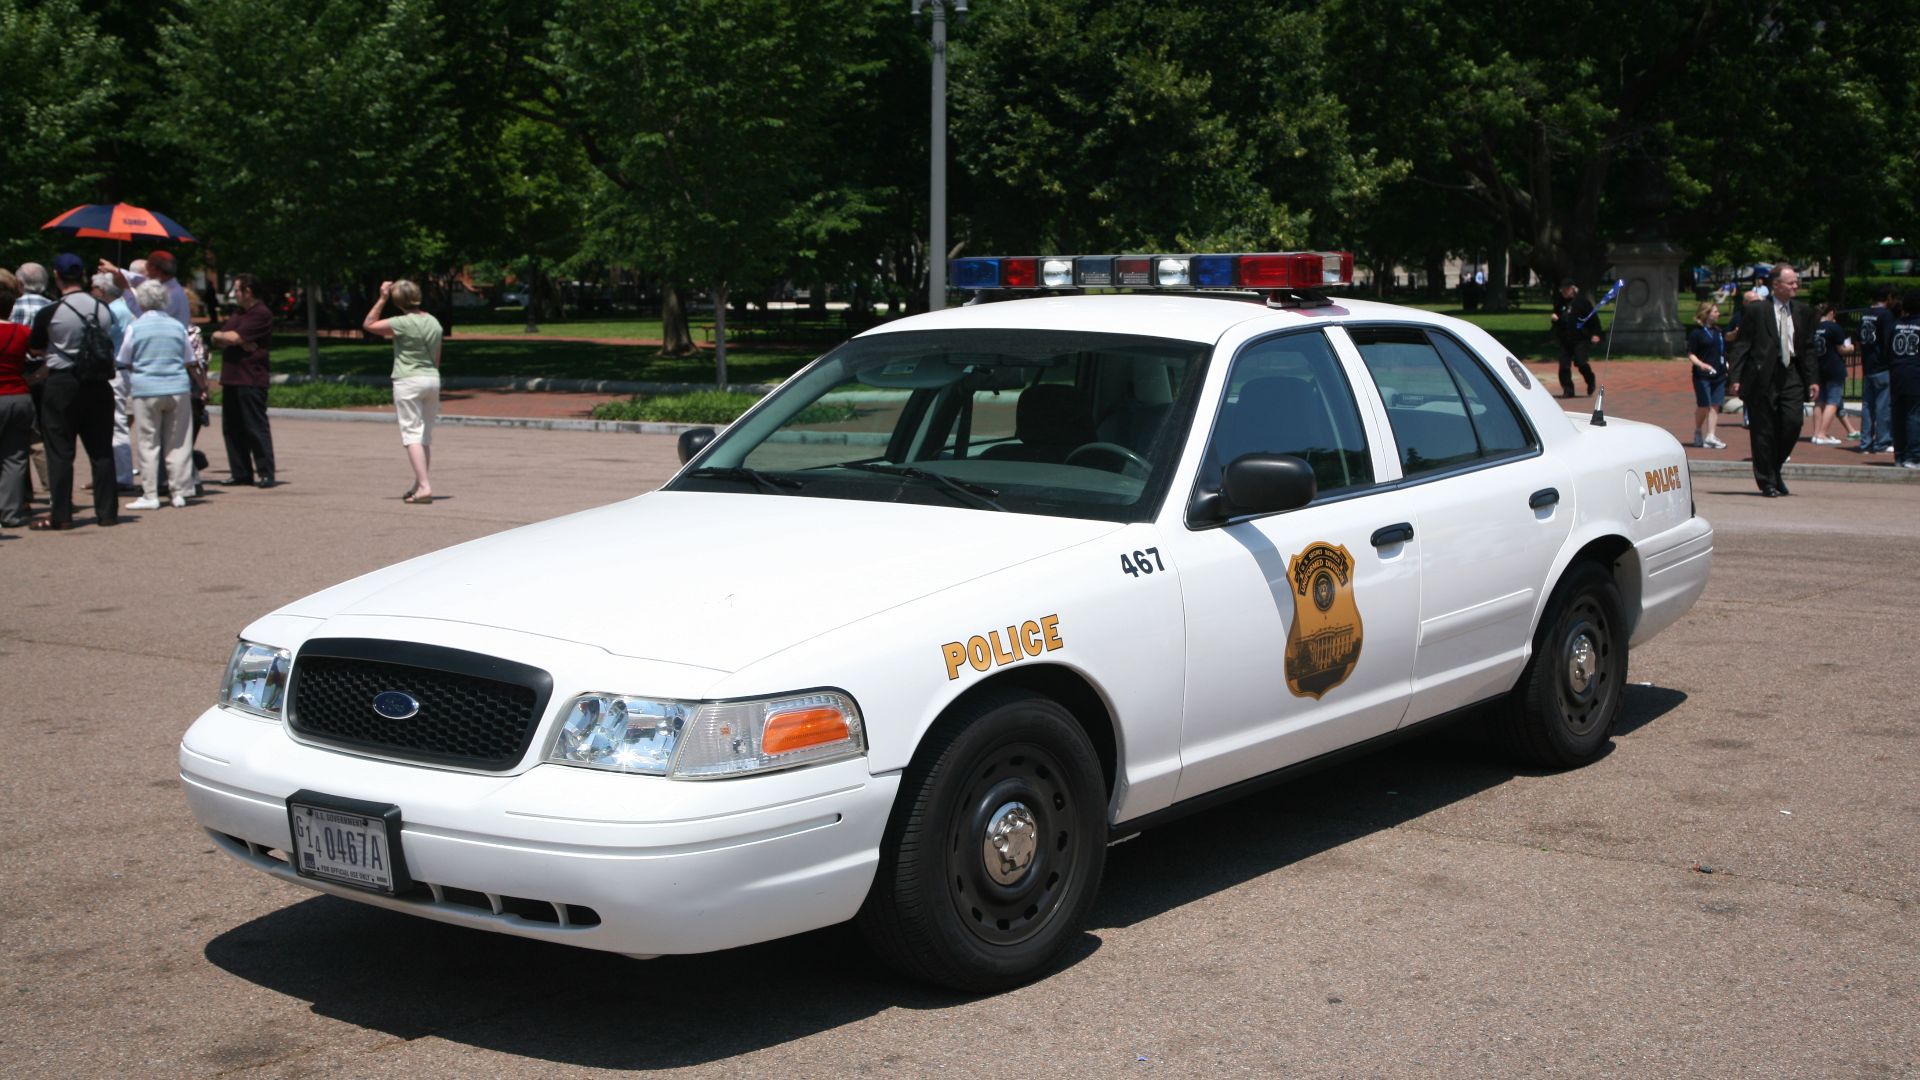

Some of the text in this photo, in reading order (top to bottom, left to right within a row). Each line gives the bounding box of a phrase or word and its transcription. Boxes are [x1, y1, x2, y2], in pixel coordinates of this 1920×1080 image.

[1645, 466, 1681, 495] POLICE
[1120, 546, 1165, 577] 467
[1301, 559, 1345, 593] UNIFORMED DIVISION
[941, 614, 1064, 681] POLICE
[324, 826, 383, 871] 0467A
